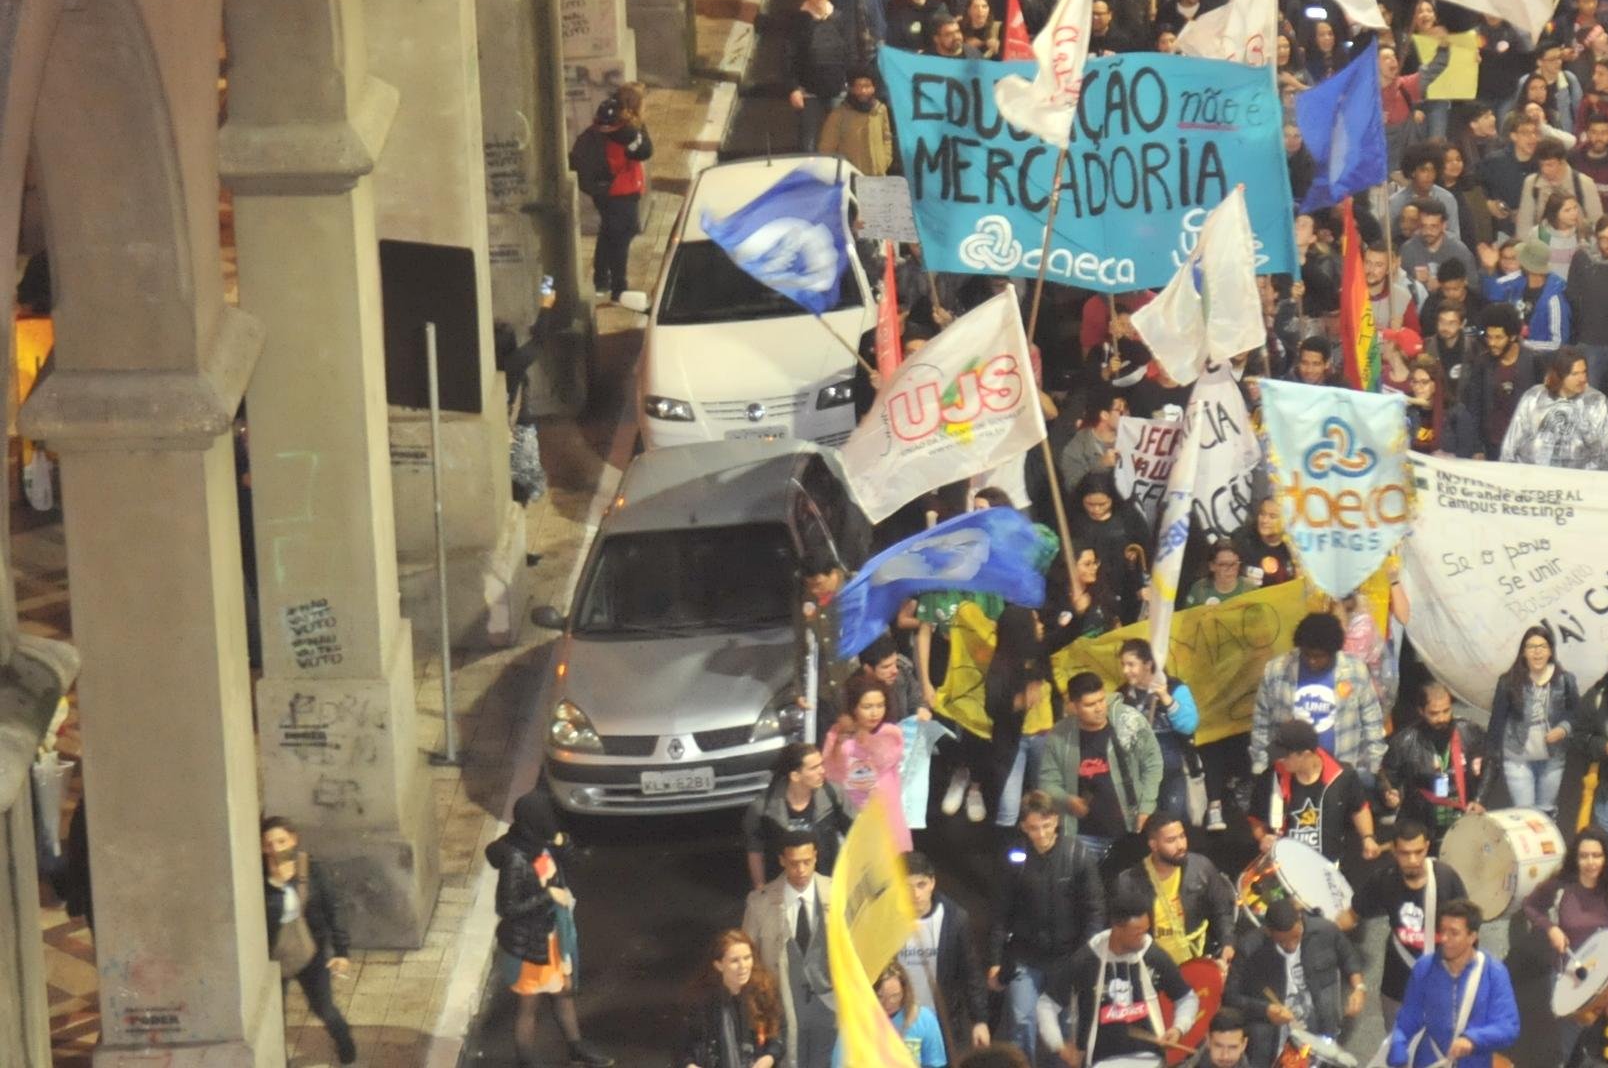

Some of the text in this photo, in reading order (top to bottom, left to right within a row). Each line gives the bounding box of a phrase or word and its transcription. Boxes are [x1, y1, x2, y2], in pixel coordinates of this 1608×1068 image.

[1180, 86, 1239, 127] não
[1246, 96, 1264, 127] é
[888, 354, 1024, 442] UJS
[1438, 494, 1576, 526] Campus Restinga
[1504, 537, 1552, 570] povo
